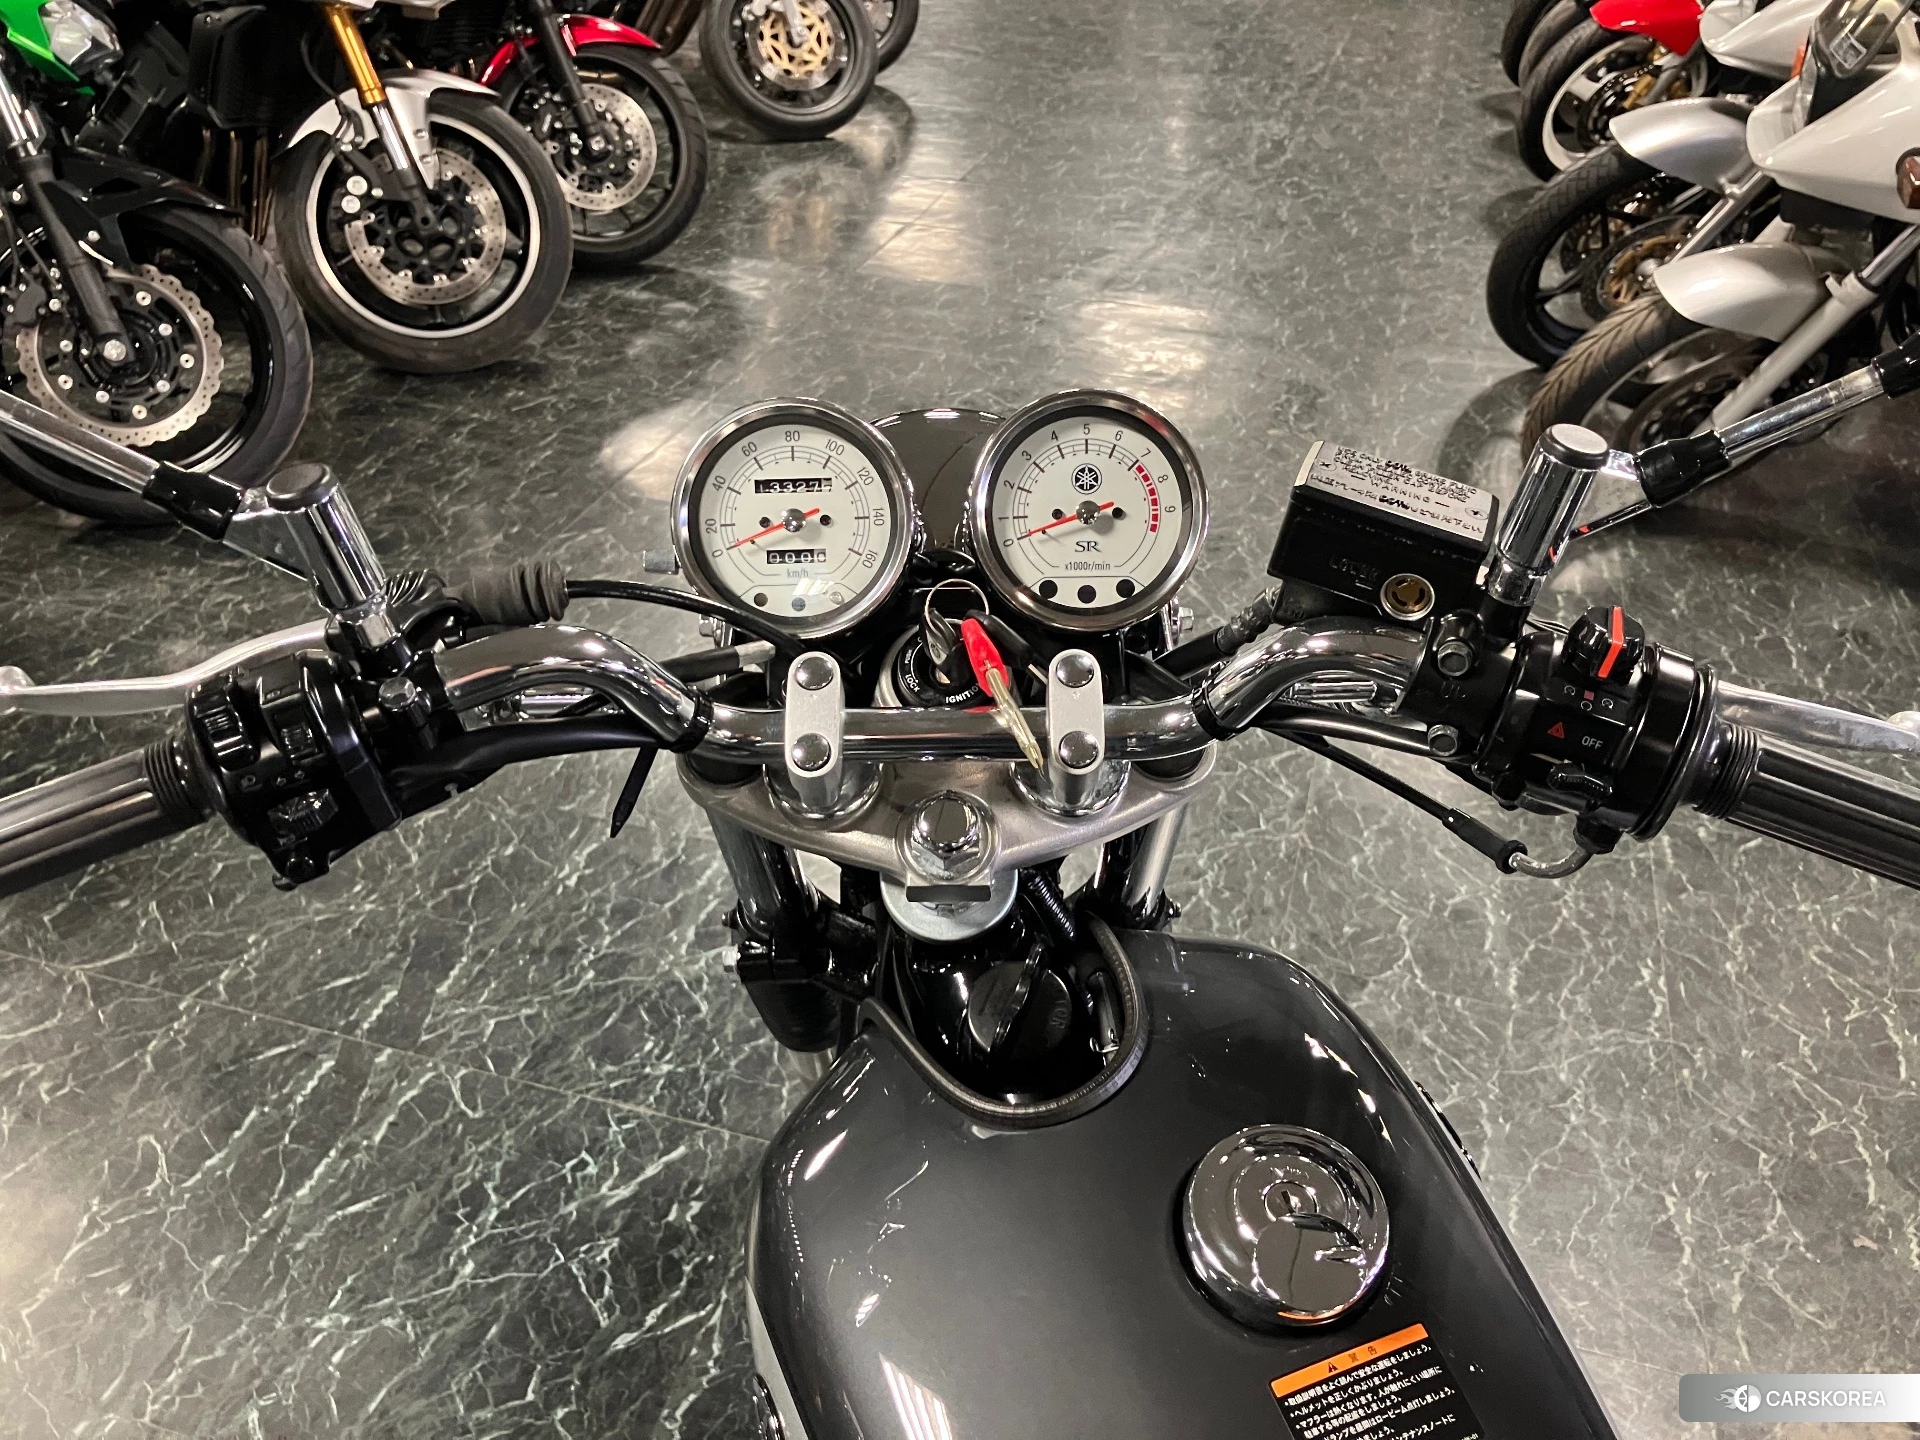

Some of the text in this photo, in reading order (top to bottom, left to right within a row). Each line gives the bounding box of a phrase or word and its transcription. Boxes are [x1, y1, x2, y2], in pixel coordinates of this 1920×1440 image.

[1083, 424, 1090, 434] 5
[785, 430, 800, 442] 80
[1050, 430, 1059, 441] 4
[1115, 430, 1122, 441] 6
[741, 441, 758, 457] 60
[825, 438, 845, 456] 100
[1022, 450, 1032, 460] 3
[1141, 448, 1151, 458] 7
[857, 467, 874, 486] 120
[1158, 474, 1168, 483] 8
[712, 475, 727, 492] 40
[1004, 480, 1015, 490] 2
[1369, 476, 1430, 504] WARNING
[1165, 505, 1176, 513] 9
[872, 507, 885, 526] 140
[706, 518, 717, 534] 20
[1003, 539, 1014, 547] 0
[1074, 541, 1101, 552] SR
[712, 549, 724, 558] 0
[862, 550, 878, 569] 160
[1065, 561, 1111, 571] x1000r/min
[787, 569, 809, 578] km/h
[905, 674, 920, 692] LOCK
[945, 686, 979, 704] IGNITIO
[1582, 735, 1603, 750] OFF
